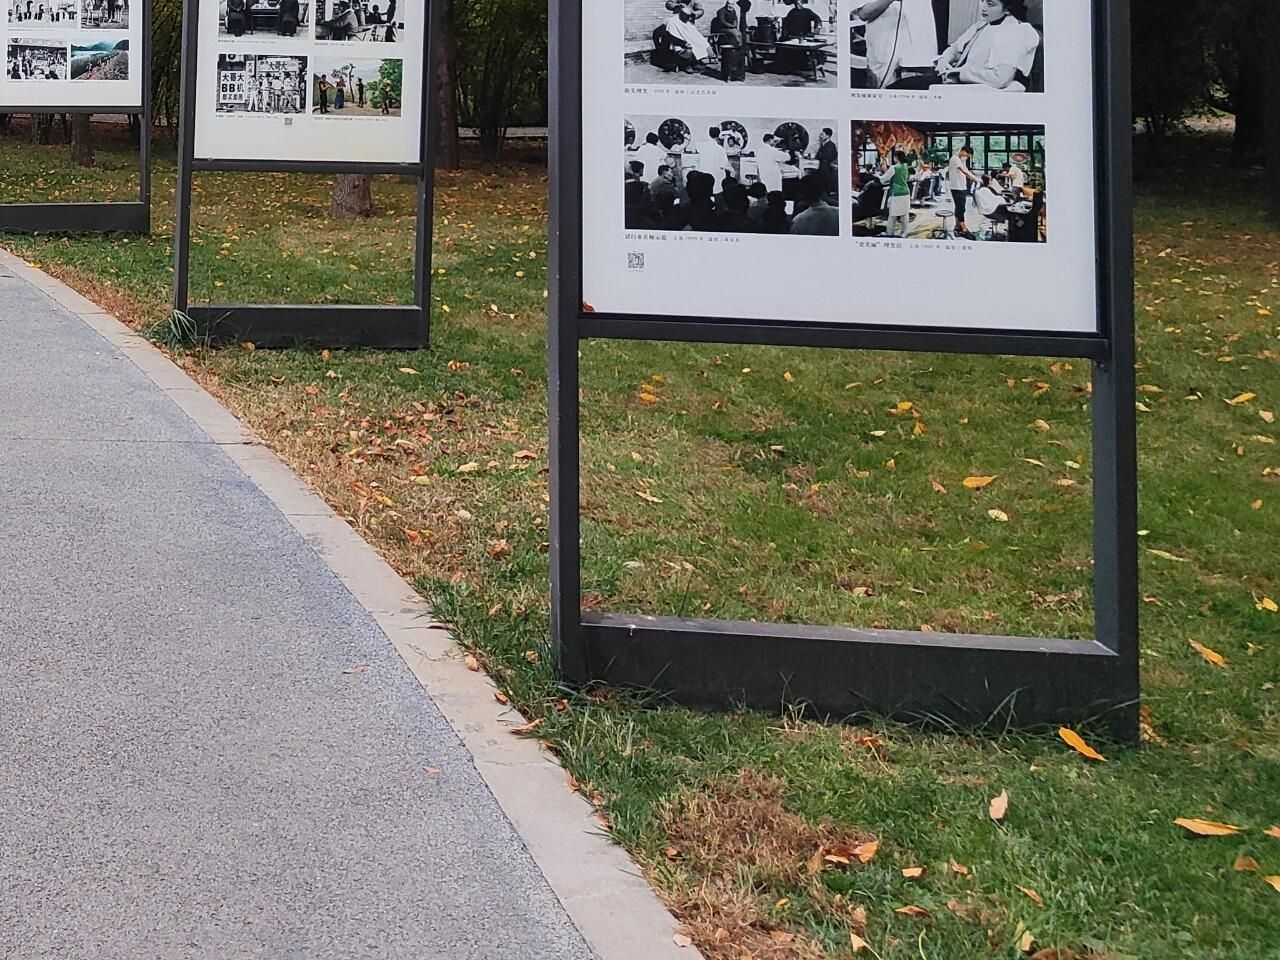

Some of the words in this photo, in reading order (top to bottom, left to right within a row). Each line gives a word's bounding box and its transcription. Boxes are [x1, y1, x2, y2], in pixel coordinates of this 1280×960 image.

[221, 72, 245, 82] 大哥大
[221, 83, 245, 93] BB机
